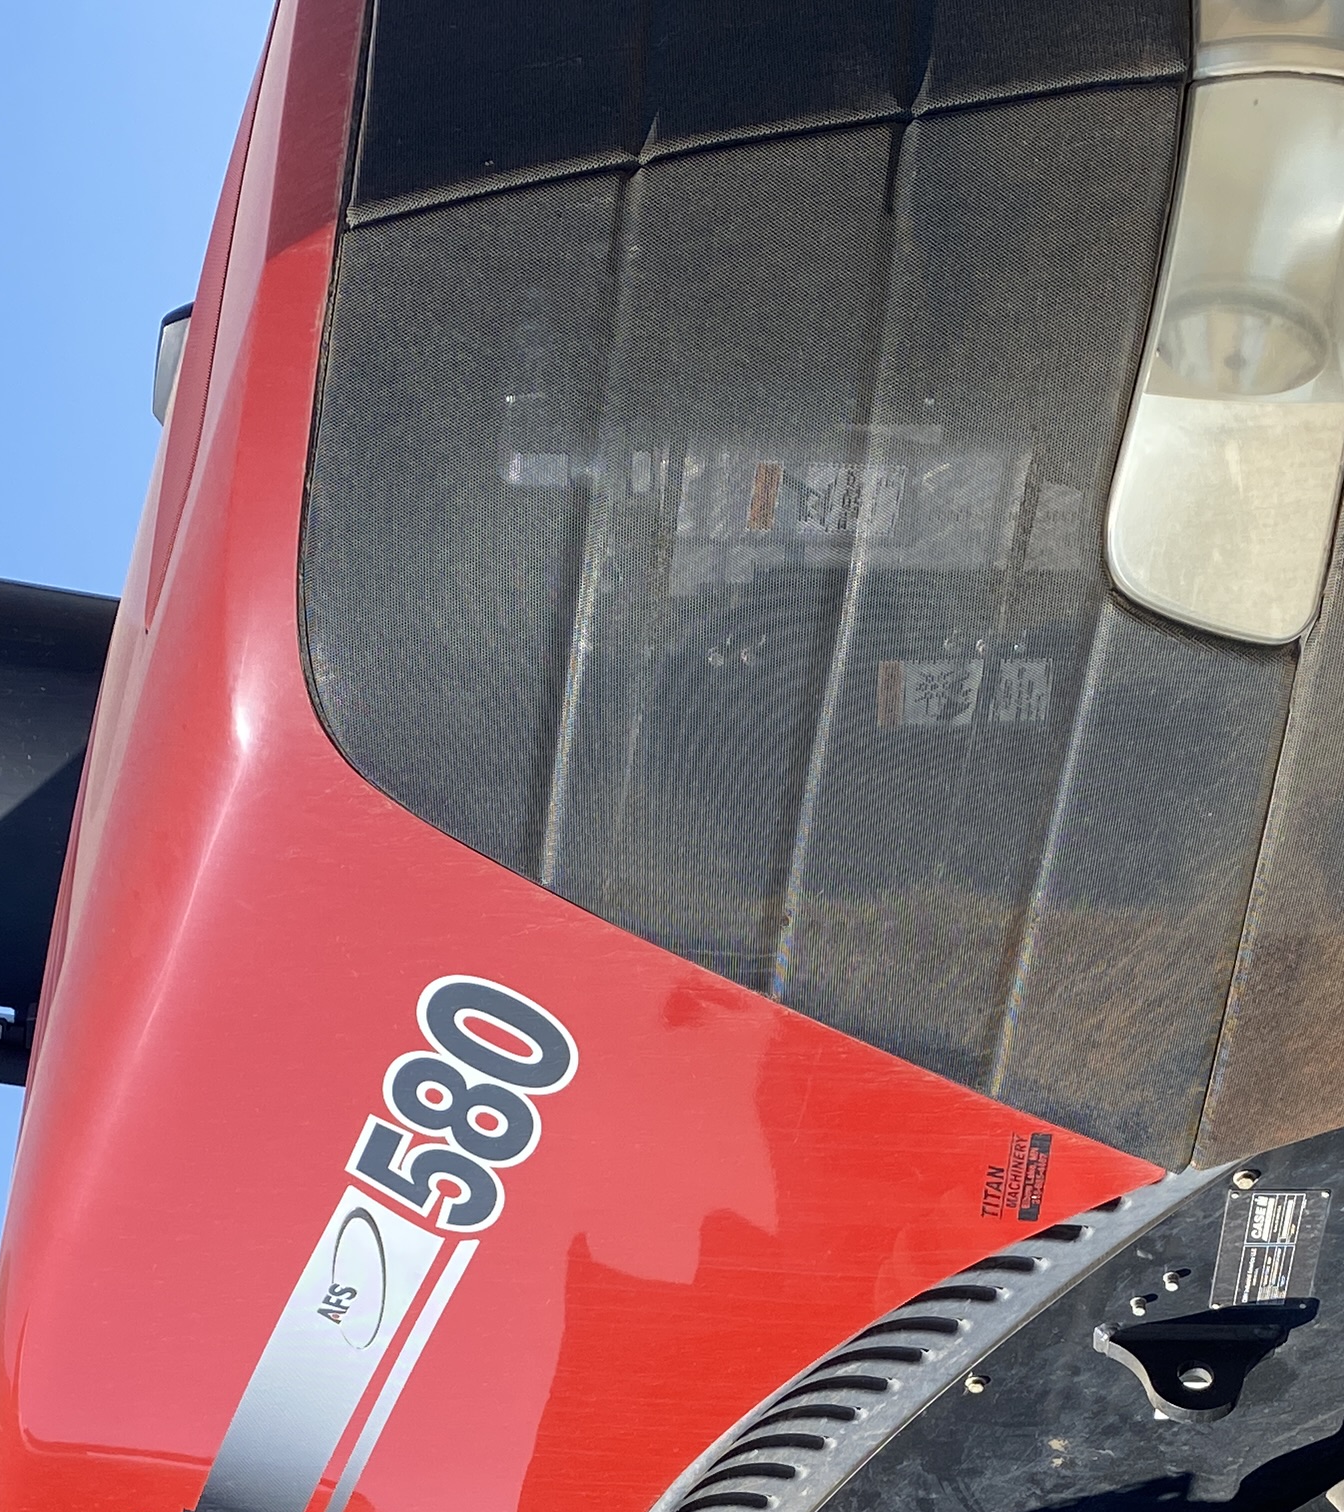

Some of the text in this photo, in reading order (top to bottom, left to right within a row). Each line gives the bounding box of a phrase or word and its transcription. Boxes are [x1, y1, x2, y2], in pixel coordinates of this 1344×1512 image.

[345, 976, 578, 1231] 580
[981, 1166, 1004, 1218] TITAN
[1006, 1136, 1027, 1208] MACHINERY
[1251, 1207, 1266, 1239] CASE
[316, 1284, 356, 1325] AFS
